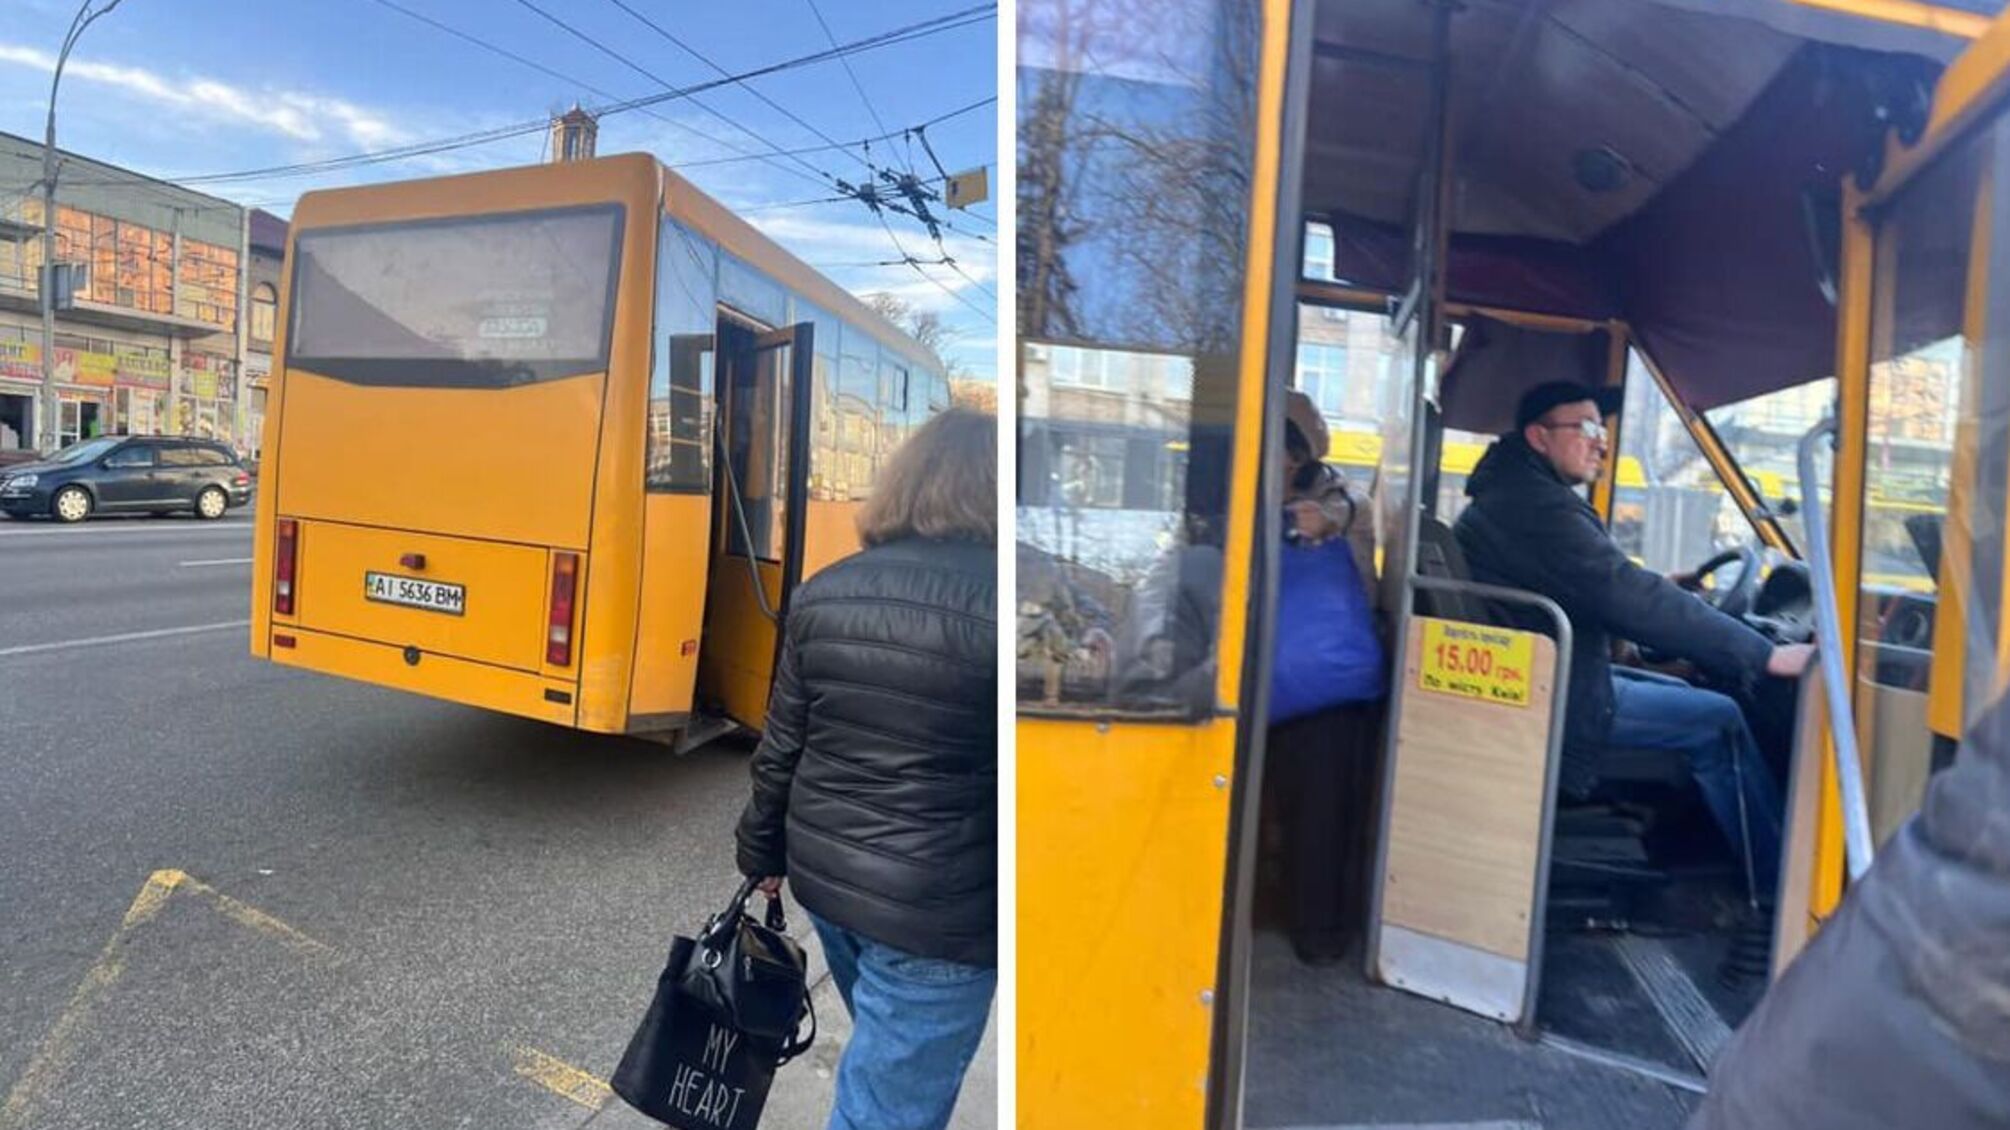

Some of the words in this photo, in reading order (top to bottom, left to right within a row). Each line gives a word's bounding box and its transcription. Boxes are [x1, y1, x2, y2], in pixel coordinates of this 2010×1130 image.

[375, 577, 393, 597] AI
[399, 581, 432, 603] 5636
[434, 586, 459, 607] BM
[1436, 643, 1492, 676] 15.00
[702, 1022, 738, 1075] MY
[668, 1063, 746, 1128] HEART
